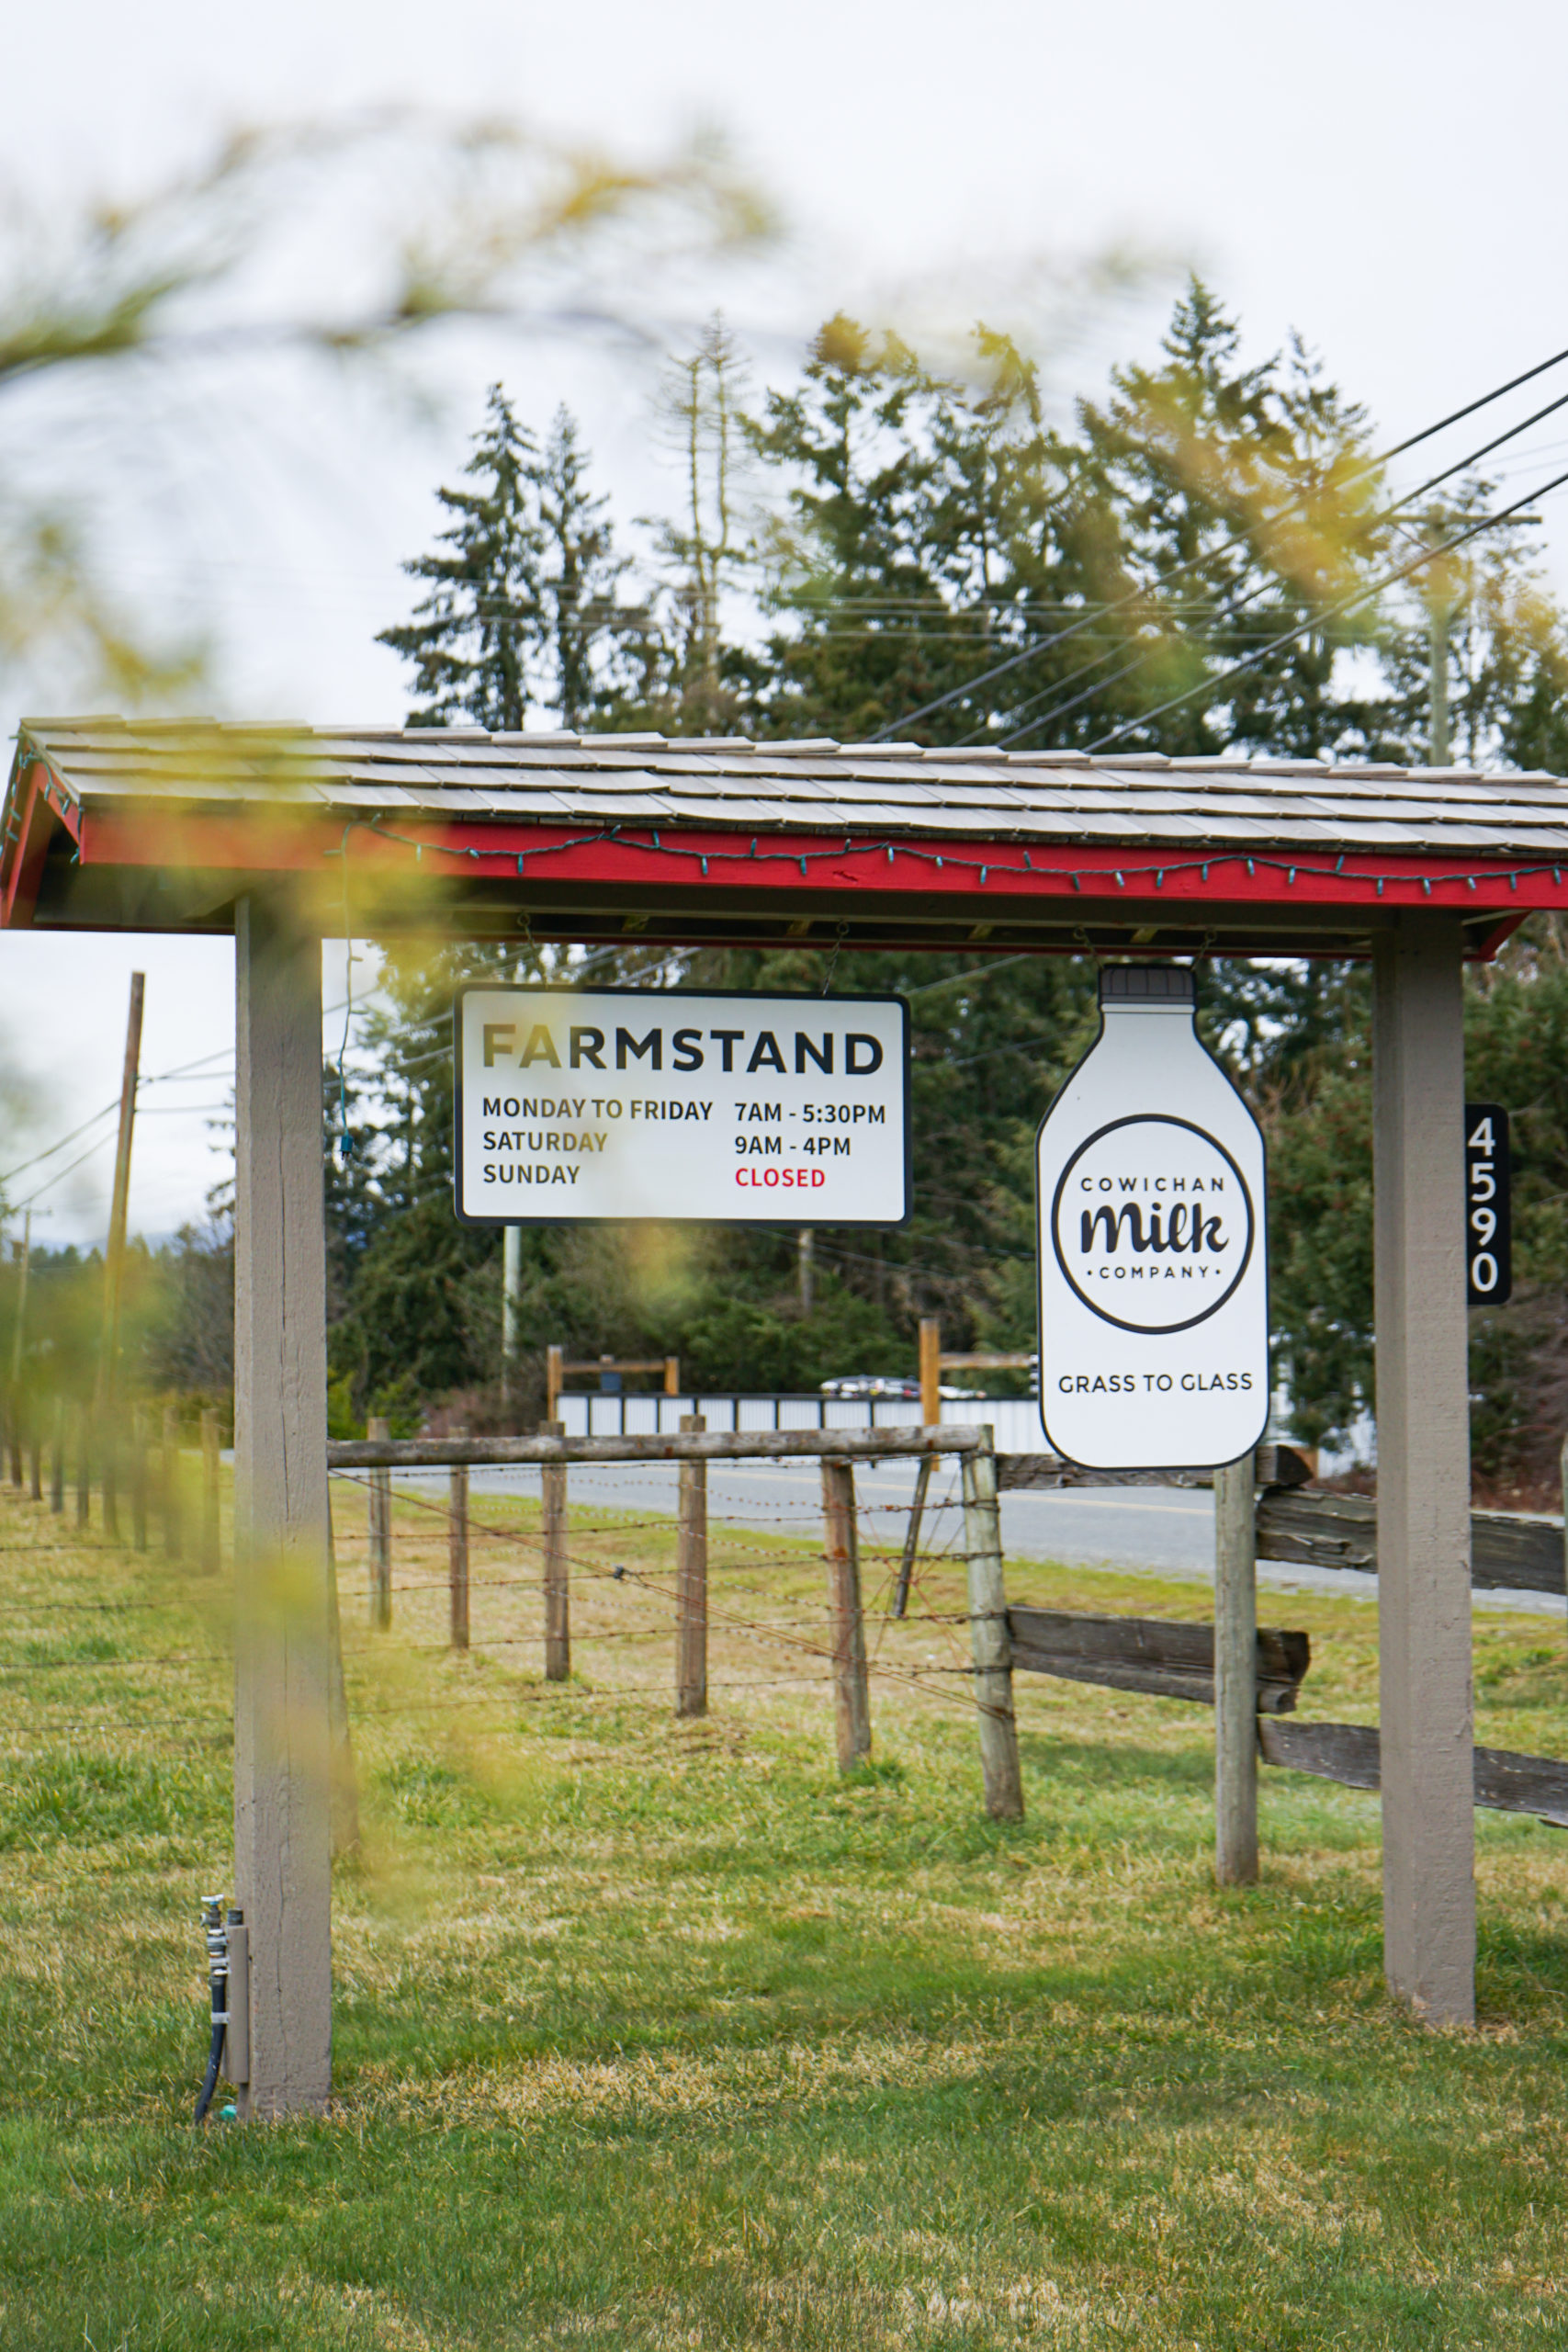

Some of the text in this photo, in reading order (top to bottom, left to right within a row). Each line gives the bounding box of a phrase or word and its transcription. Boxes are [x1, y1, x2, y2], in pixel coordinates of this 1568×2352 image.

[482, 1023, 884, 1075] FARMSTAND
[482, 1096, 586, 1119] MONDAY
[592, 1098, 622, 1119] TO
[630, 1100, 713, 1121] FRIDAY
[734, 1102, 782, 1123] 7AM
[802, 1103, 886, 1125] 5:30PM
[482, 1130, 608, 1152] SATURDAY
[735, 1136, 782, 1155] 9AM
[802, 1136, 852, 1156] 4PM
[482, 1163, 826, 1188] SUNDAY CLOSED
[1080, 1177, 1225, 1193] COWICHAN
[1467, 1116, 1498, 1293] 4590
[1080, 1201, 1229, 1254] milk
[1058, 1372, 1253, 1394] GRASS TO GLASS
